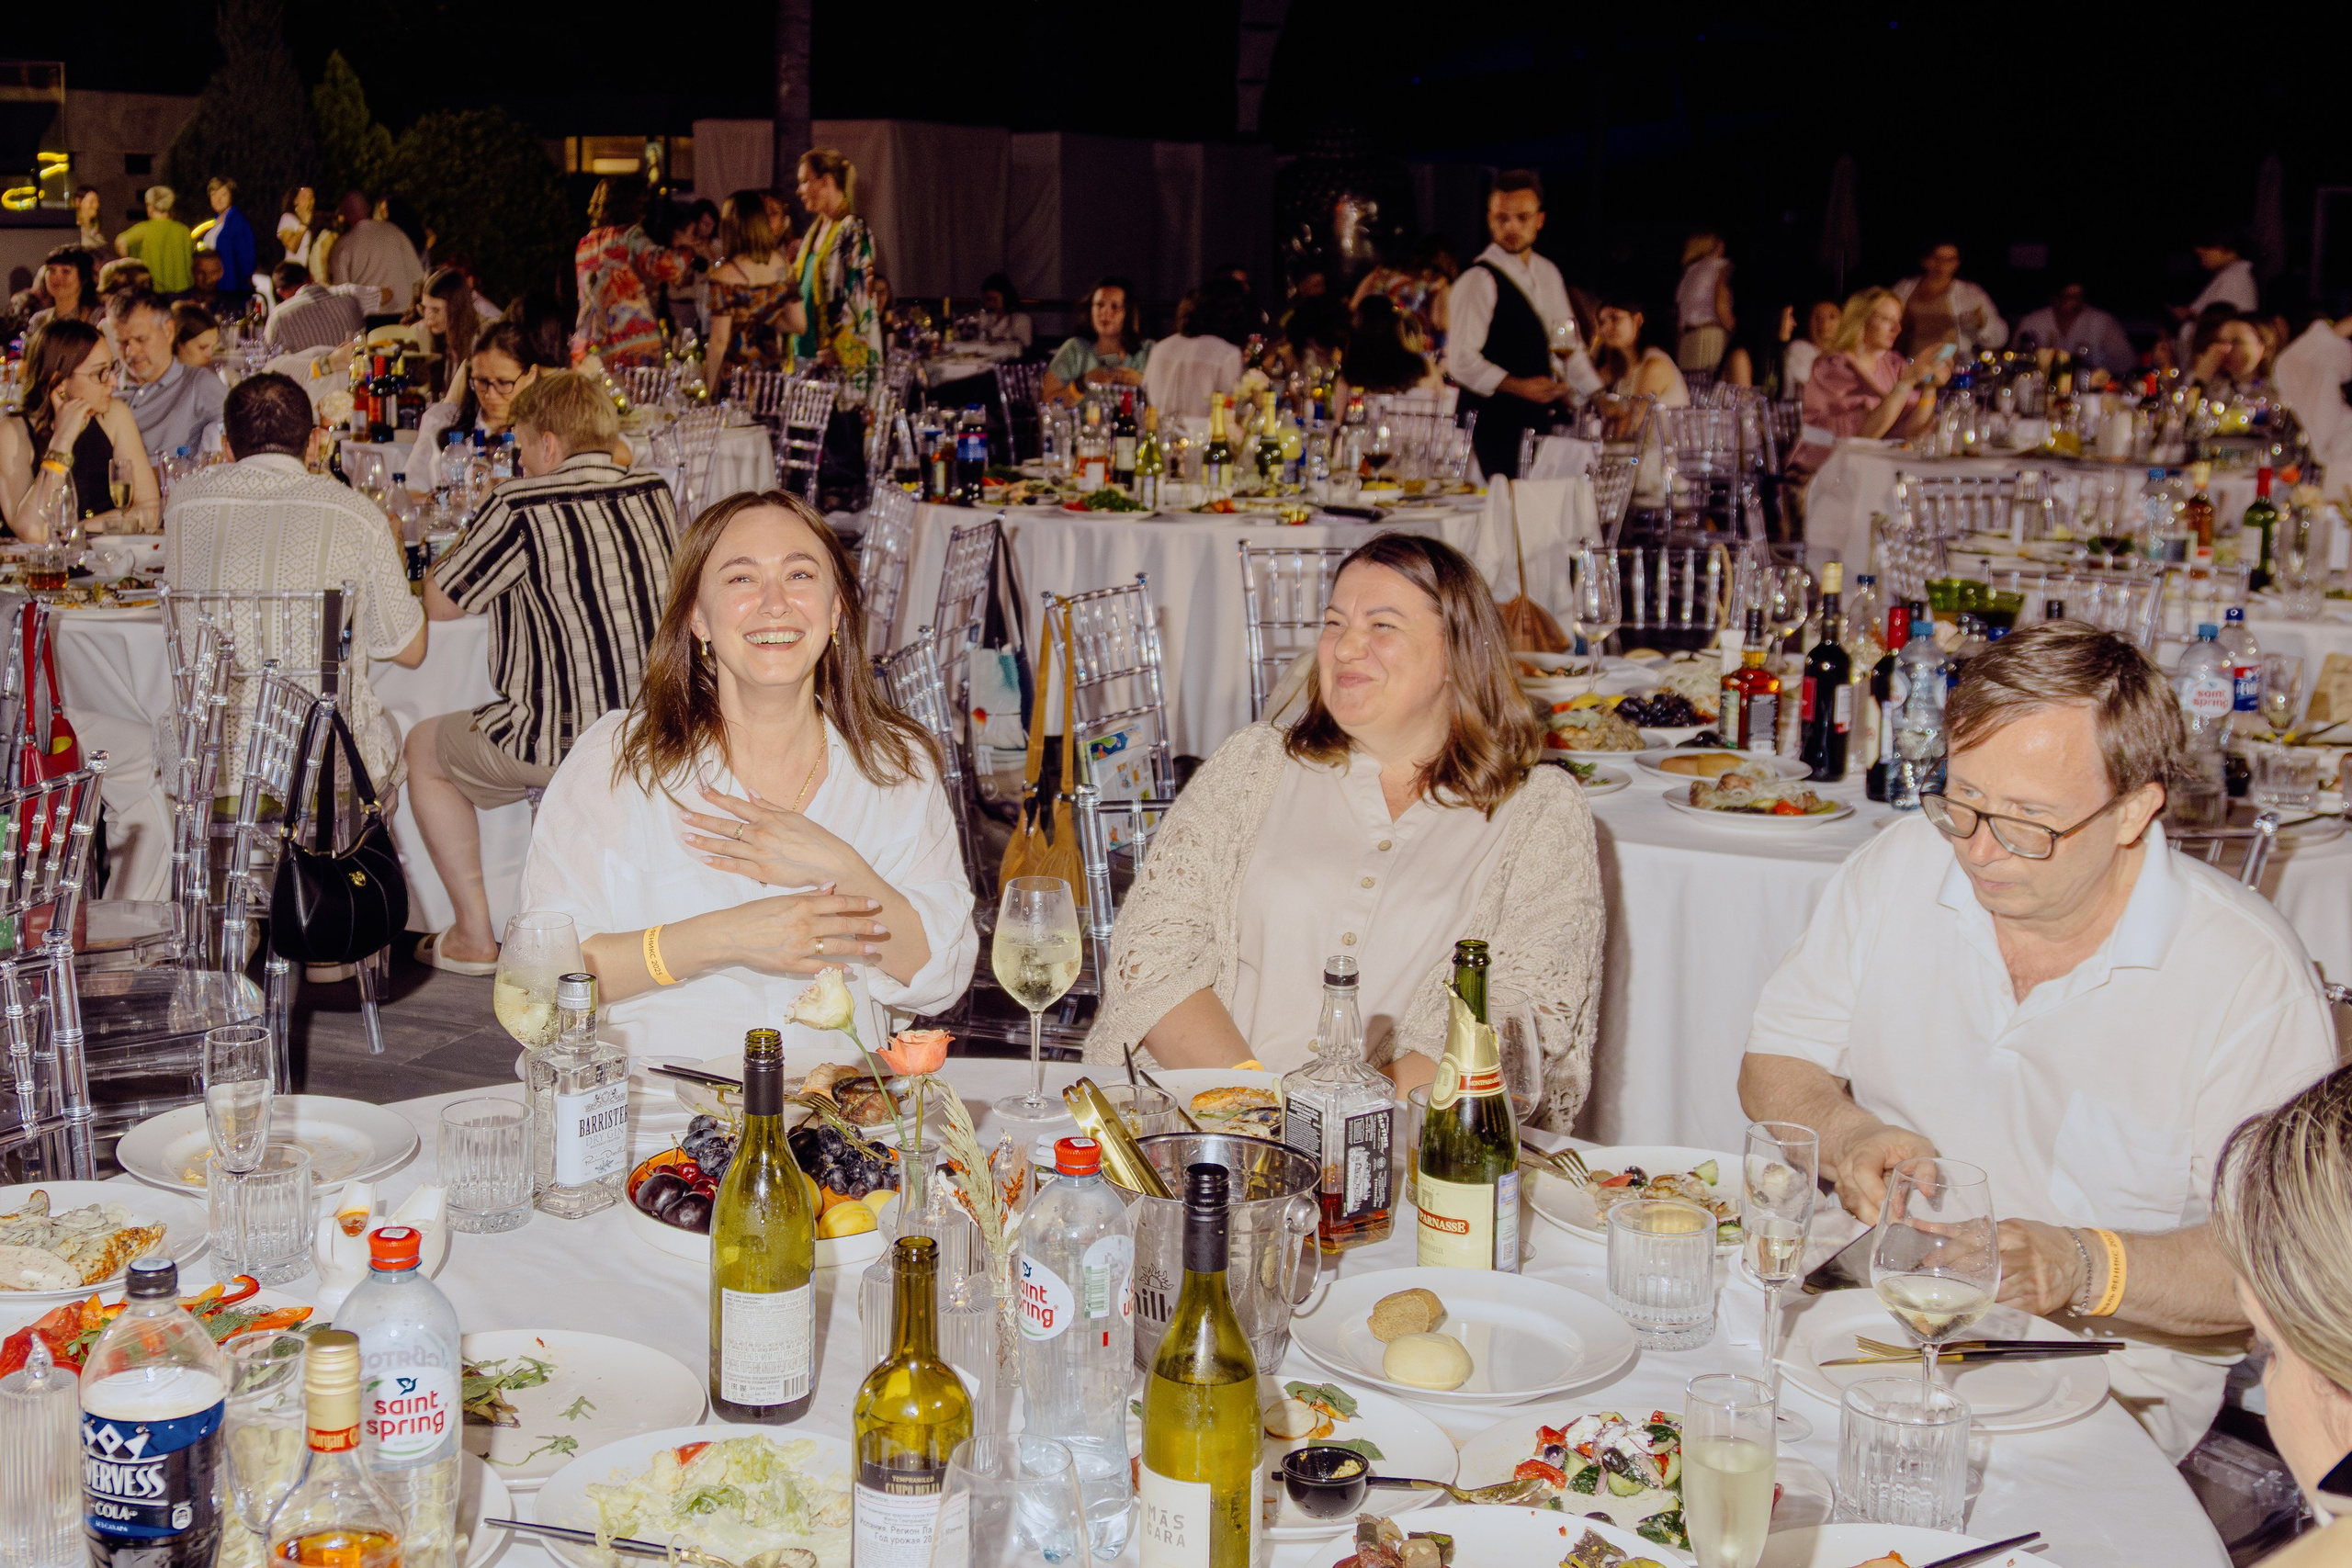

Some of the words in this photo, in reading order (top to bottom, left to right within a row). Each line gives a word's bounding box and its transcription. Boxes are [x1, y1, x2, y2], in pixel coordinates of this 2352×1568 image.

[2192, 698, 2229, 710] spring
[650, 960, 663, 976] 2025
[585, 1132, 605, 1147] DRY
[606, 1125, 625, 1140] GIN
[1020, 1279, 1047, 1304] aint
[374, 1390, 439, 1416] saint
[366, 1410, 445, 1443] spring
[891, 1474, 935, 1483] TEMPRANILLO
[95, 1501, 130, 1521] COLA
[874, 1532, 888, 1543] Год
[890, 1536, 921, 1546] урожая
[890, 1526, 920, 1536] Регион
[922, 1526, 933, 1535] Ла
[1147, 1521, 1185, 1548] CARA
